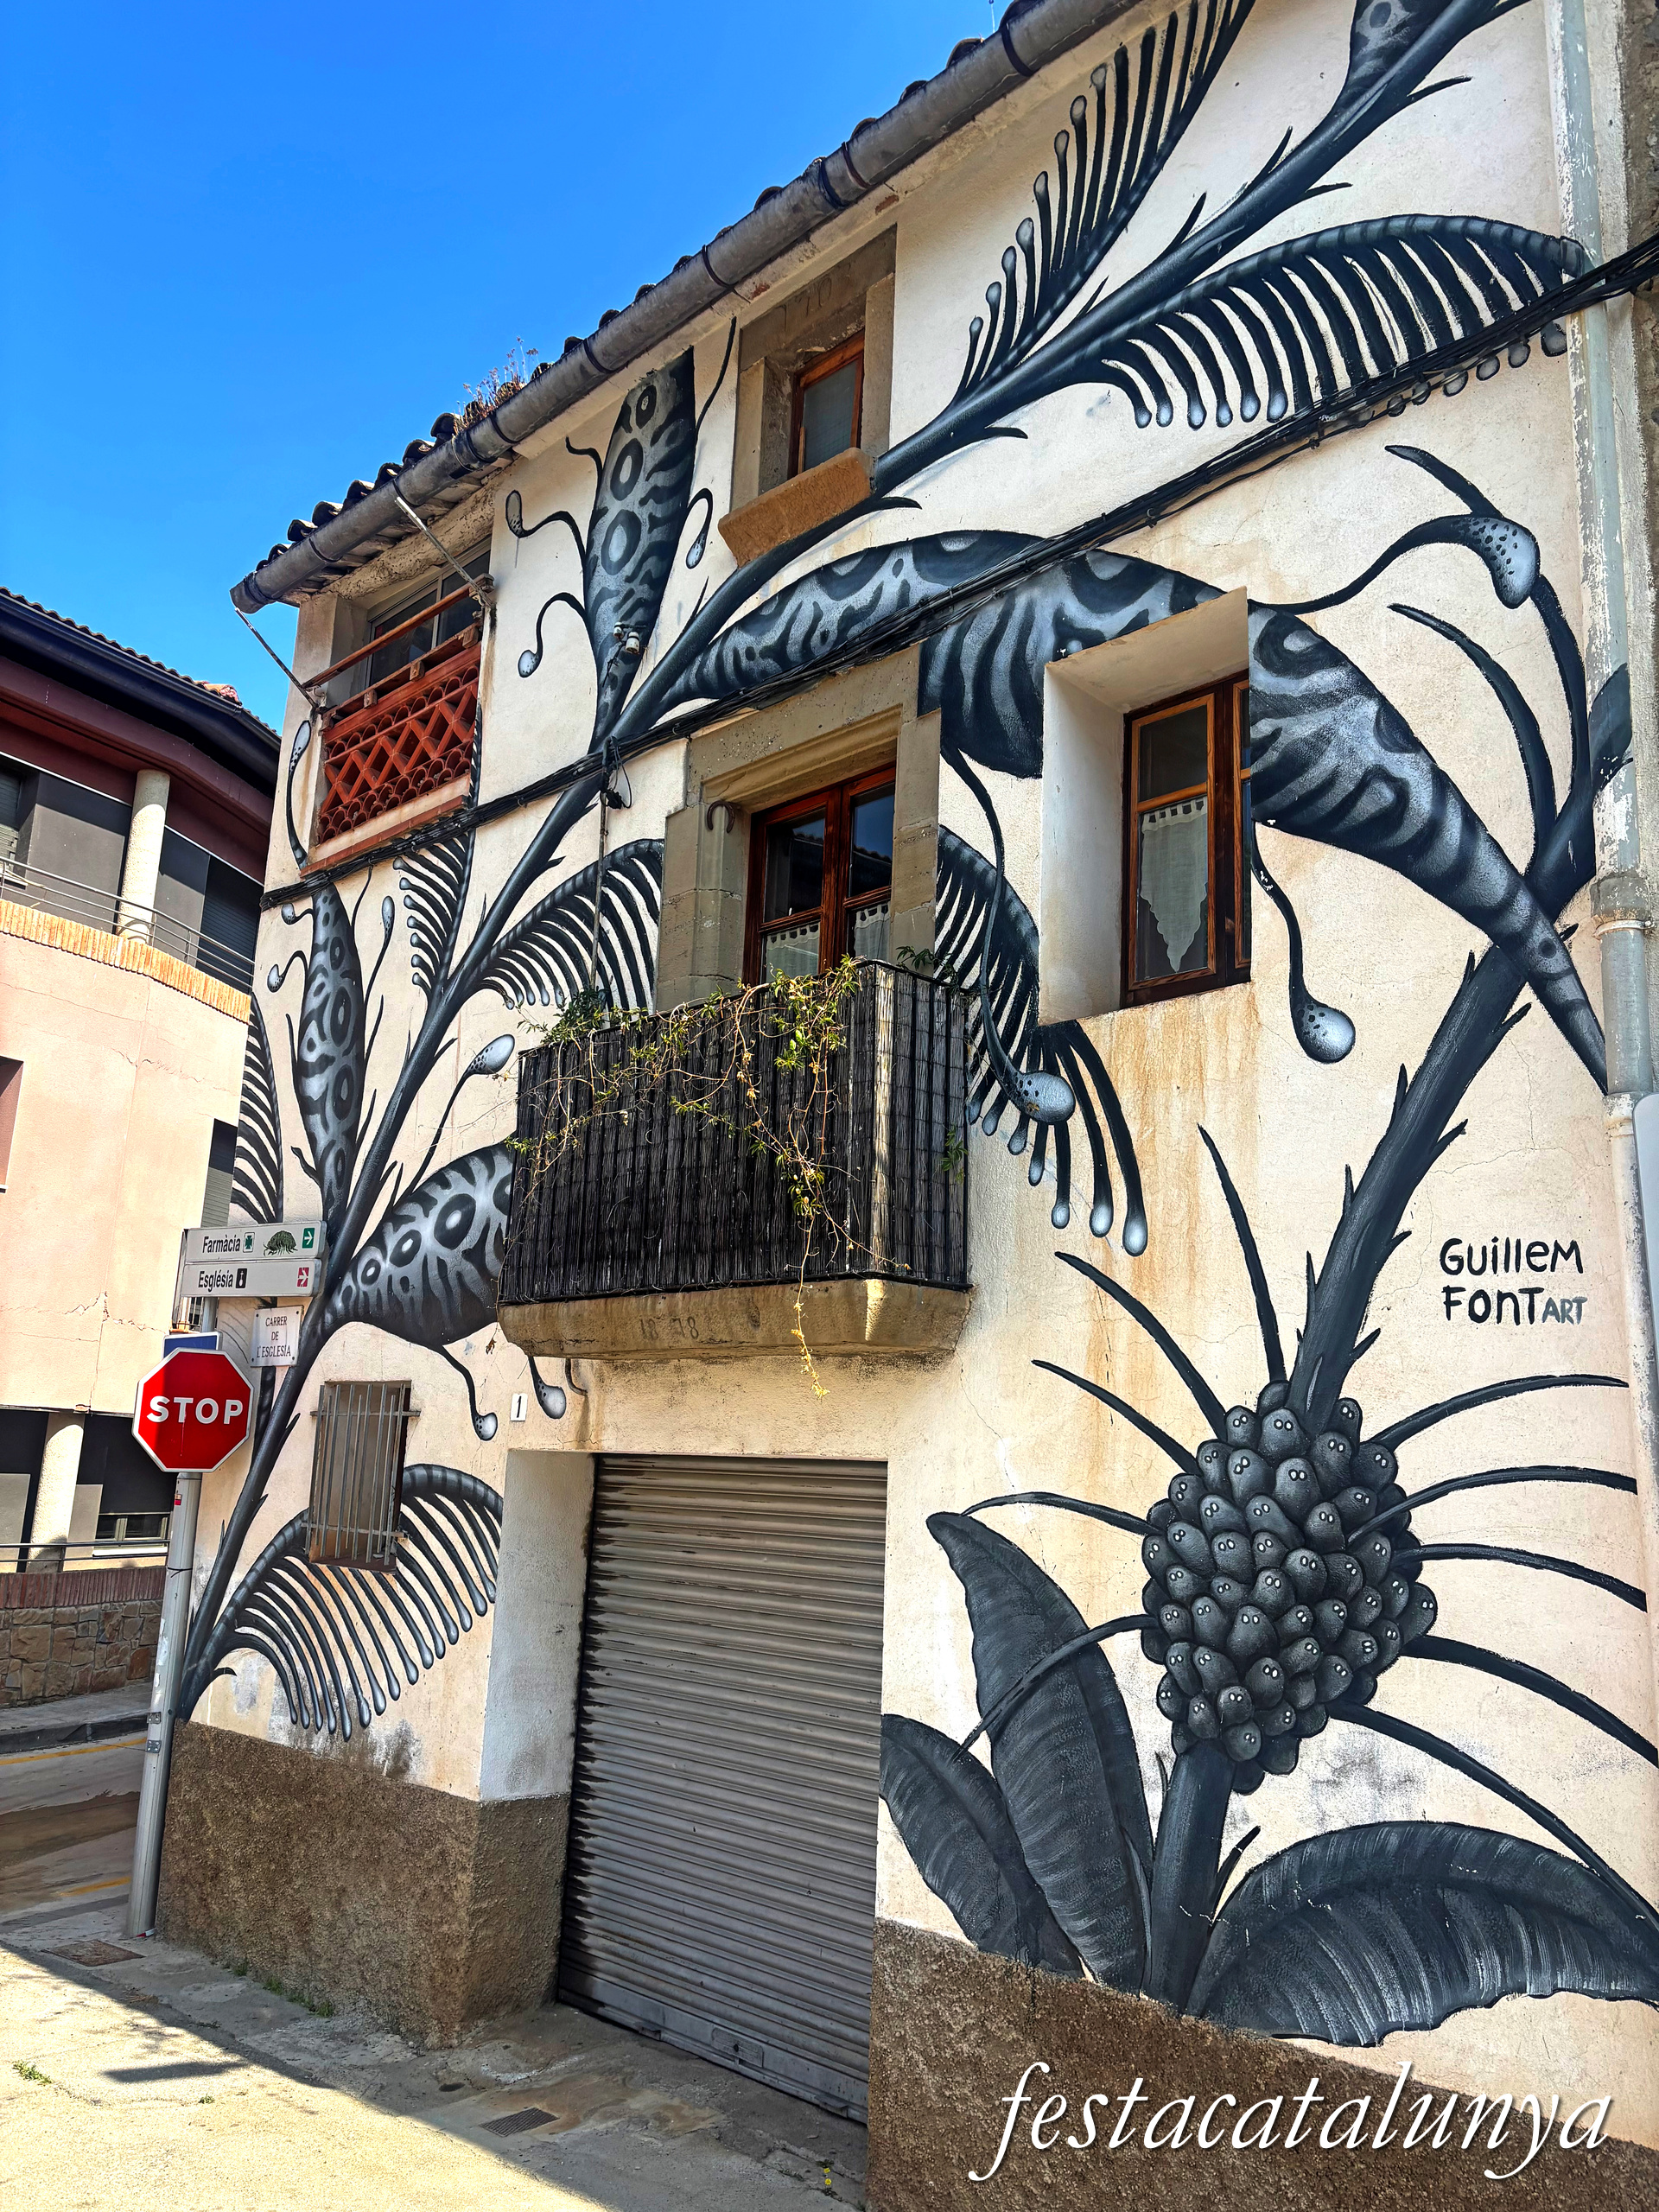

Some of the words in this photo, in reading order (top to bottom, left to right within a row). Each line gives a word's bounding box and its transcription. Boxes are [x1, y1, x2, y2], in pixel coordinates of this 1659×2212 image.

[202, 1234, 241, 1253] Farmàcia
[198, 1269, 233, 1293] Església
[265, 1316, 288, 1326] CARRER
[271, 1332, 279, 1340] DE
[146, 1395, 244, 1425] STOP
[516, 1395, 522, 1418] 1
